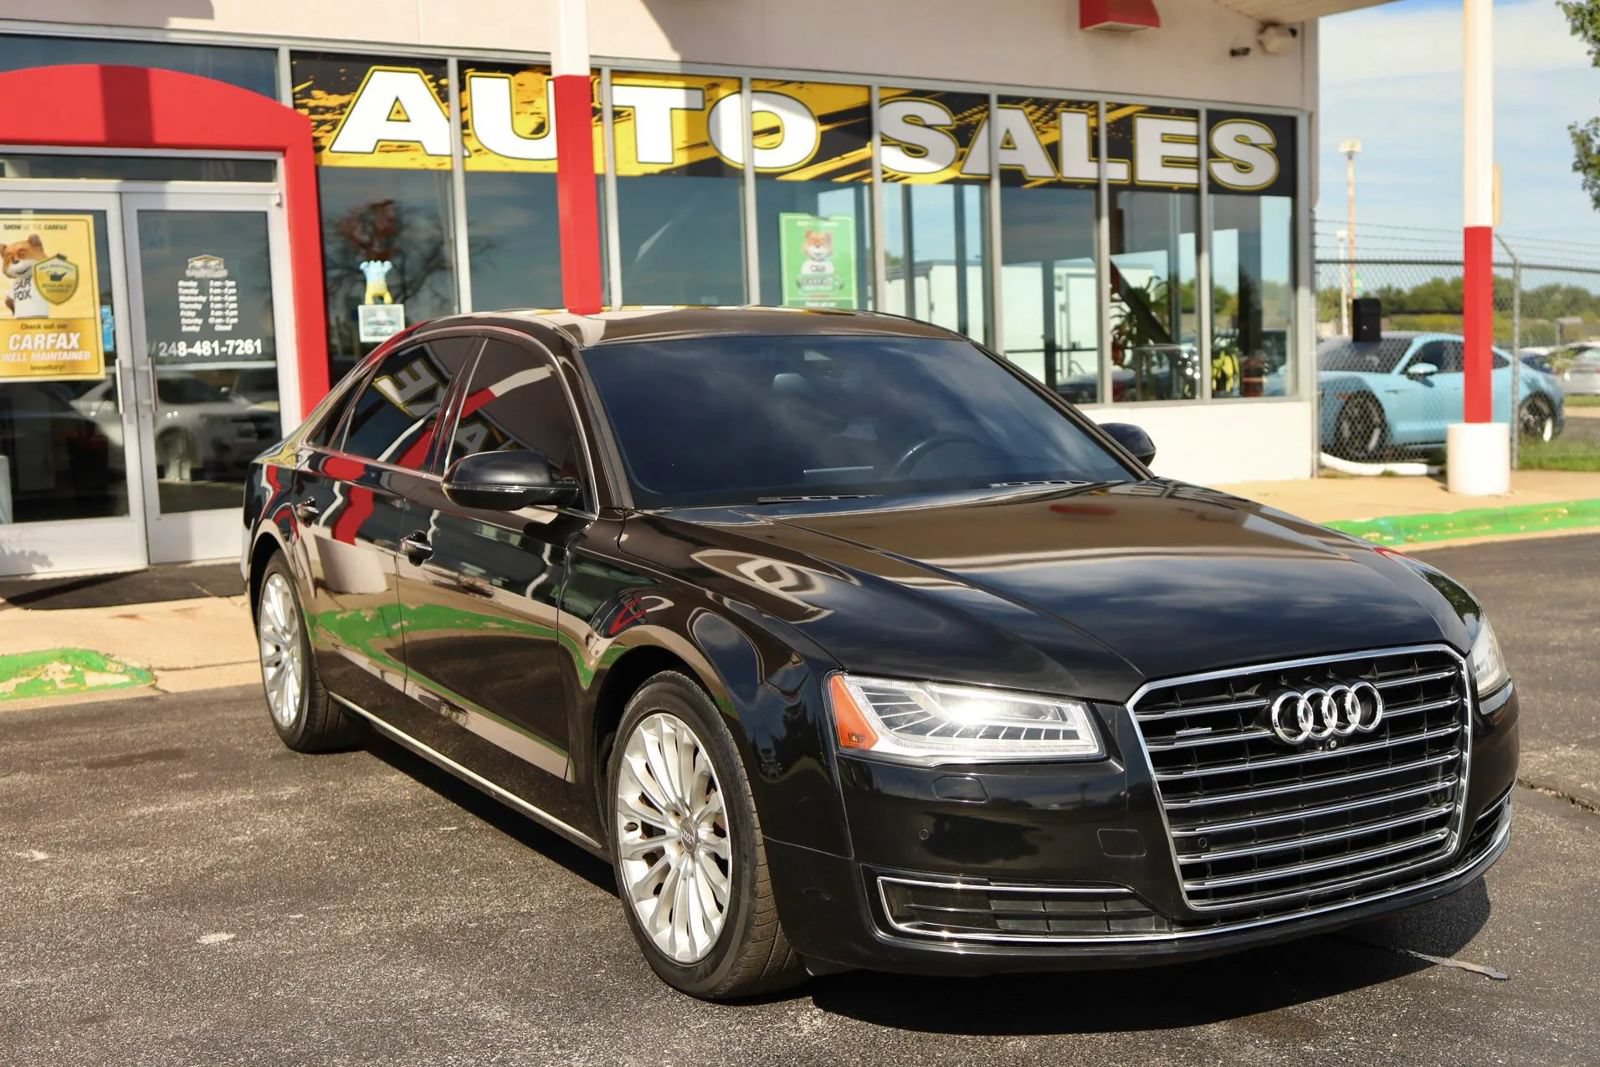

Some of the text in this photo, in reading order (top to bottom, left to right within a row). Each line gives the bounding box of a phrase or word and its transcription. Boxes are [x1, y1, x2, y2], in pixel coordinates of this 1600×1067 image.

[328, 68, 1279, 190] AUTO SALES
[9, 332, 81, 351] CARFAX
[158, 338, 262, 357] 248-481-7261
[2, 350, 91, 362] WELL MAINTAINED
